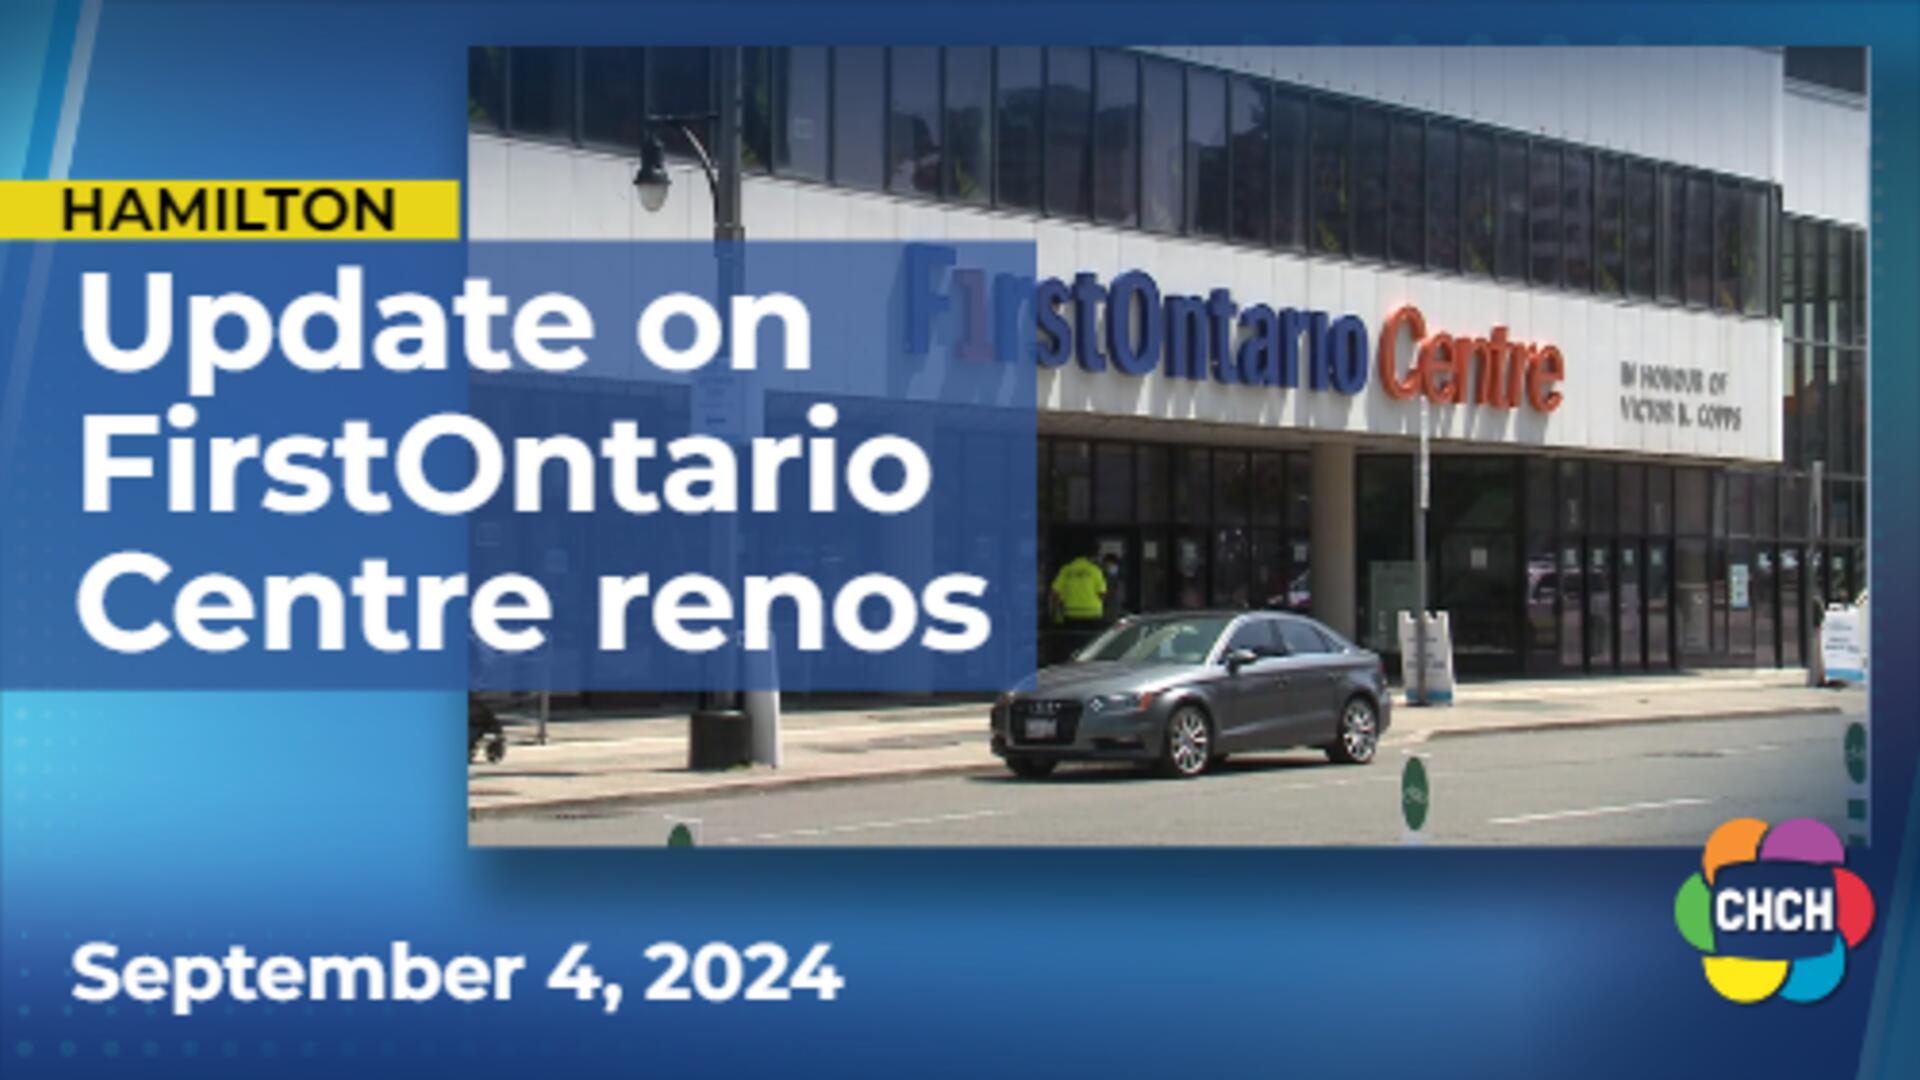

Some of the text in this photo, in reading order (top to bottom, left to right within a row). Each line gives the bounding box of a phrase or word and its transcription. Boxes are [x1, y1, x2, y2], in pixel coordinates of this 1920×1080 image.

[1376, 304, 1565, 413] Centre
[1640, 364, 1703, 395] HONOUR
[1709, 371, 1728, 396] OF
[1620, 395, 1675, 425] VICTOR
[1698, 403, 1742, 432] COPPS
